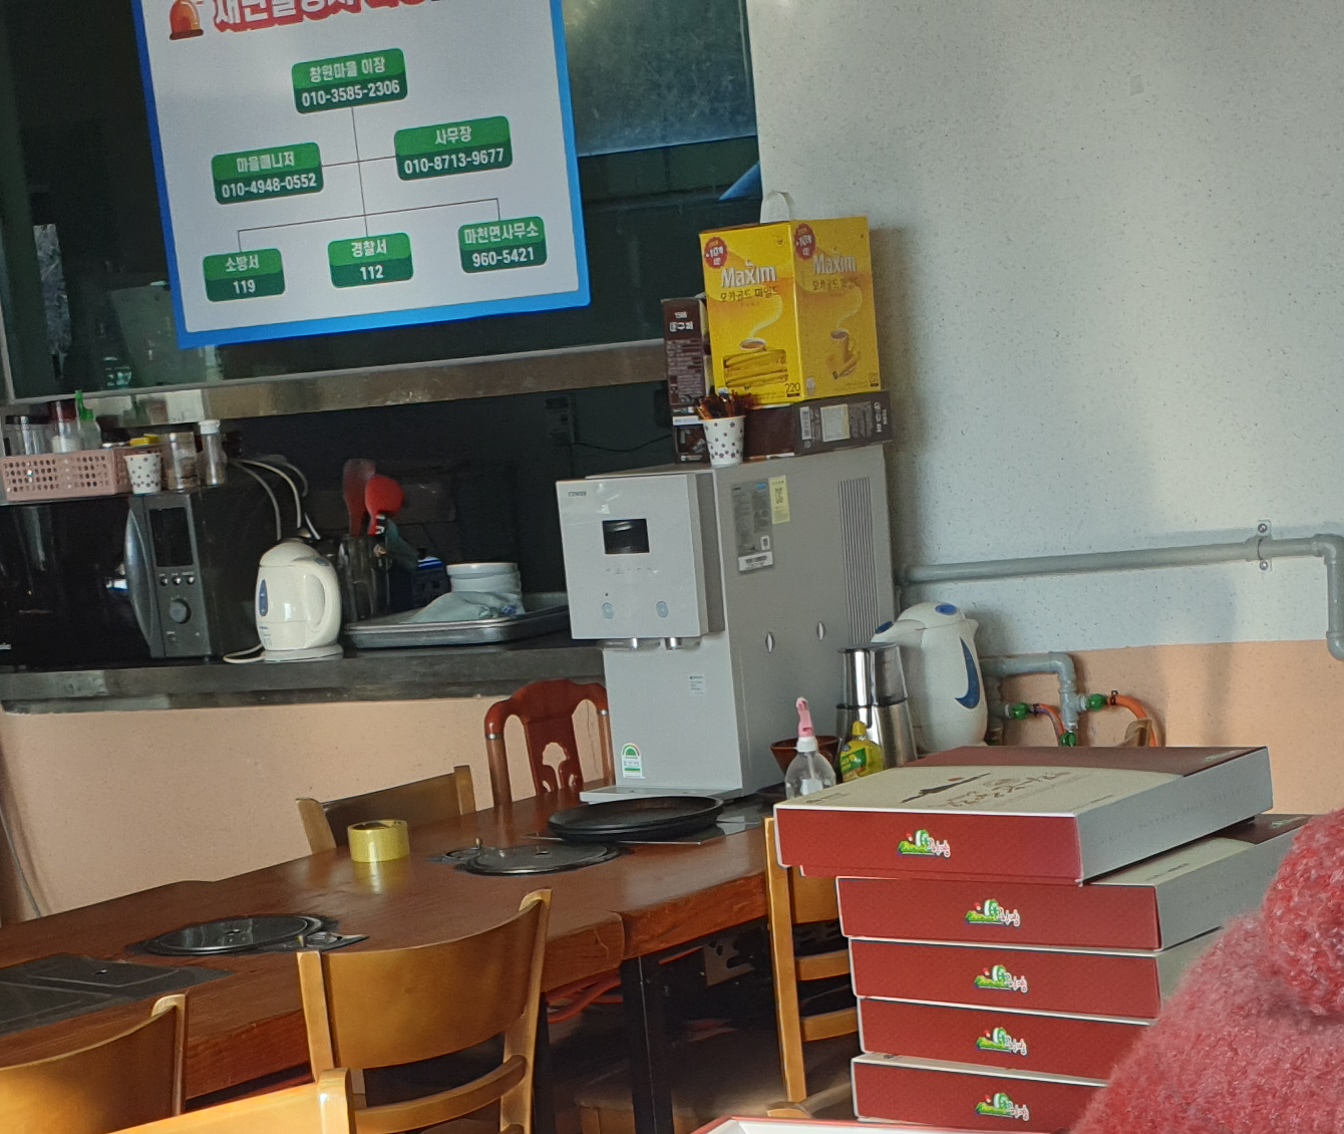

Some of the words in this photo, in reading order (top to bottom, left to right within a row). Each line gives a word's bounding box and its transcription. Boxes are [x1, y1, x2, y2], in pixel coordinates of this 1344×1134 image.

[309, 60, 358, 83] 창원마을
[361, 56, 385, 74] 이장
[302, 79, 400, 107] 010-3585-2306
[435, 126, 472, 145] 사무장
[404, 148, 504, 174] 010-8713-9677
[221, 172, 317, 198] 010-4948-0552
[464, 221, 539, 244] 마천면사무소
[351, 238, 387, 257] 경찰서
[472, 246, 534, 267] 960-5421
[225, 254, 259, 272] 소방서
[359, 264, 384, 280] 112
[813, 253, 857, 275] Maxim
[233, 279, 256, 294] 119
[722, 266, 777, 288] Maxim
